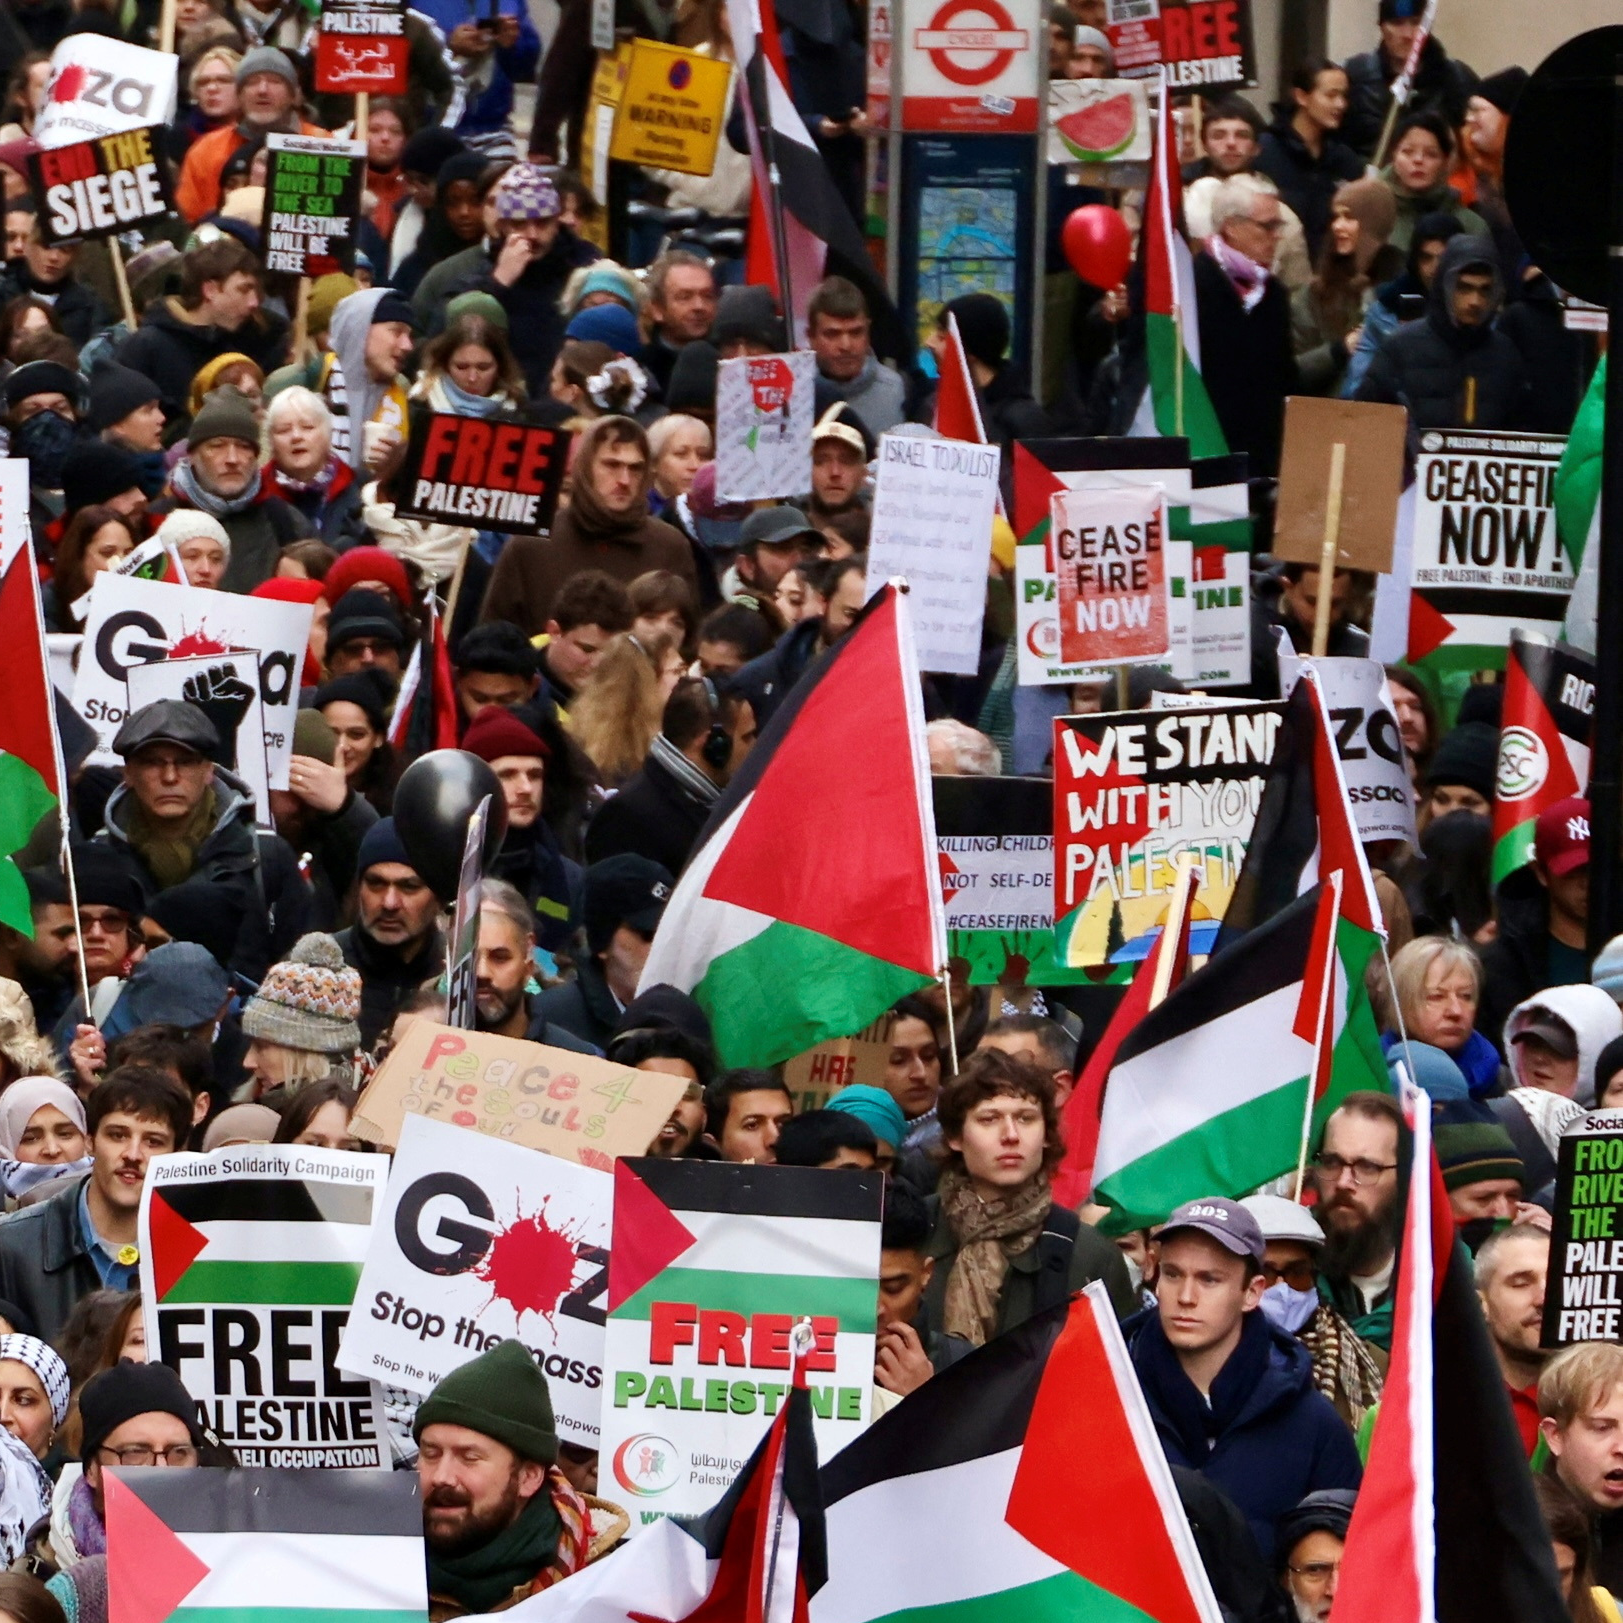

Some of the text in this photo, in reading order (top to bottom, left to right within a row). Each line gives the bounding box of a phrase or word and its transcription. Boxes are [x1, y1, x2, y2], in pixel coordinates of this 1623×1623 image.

[40, 128, 153, 187] END THE
[276, 152, 351, 177] FROM THE
[48, 163, 166, 237] SIEGE
[305, 195, 334, 215] SEA
[269, 235, 305, 255] WILL
[271, 214, 349, 238] PALESTINE
[266, 254, 306, 273] FREE
[421, 415, 554, 494] FREE
[885, 440, 927, 468] ISRAEL
[413, 479, 541, 524] PALESTINE
[1057, 520, 1161, 560] CEASE
[1076, 559, 1148, 596] FIRE
[1076, 596, 1152, 634] NOW
[1062, 724, 1147, 779] WE
[1067, 784, 1183, 833] WITH
[422, 1033, 643, 1113] Peace 4
[808, 1053, 855, 1084] HAS
[154, 1157, 375, 1180] Palestine Solidarity Campaign
[370, 1290, 501, 1354] Stop the
